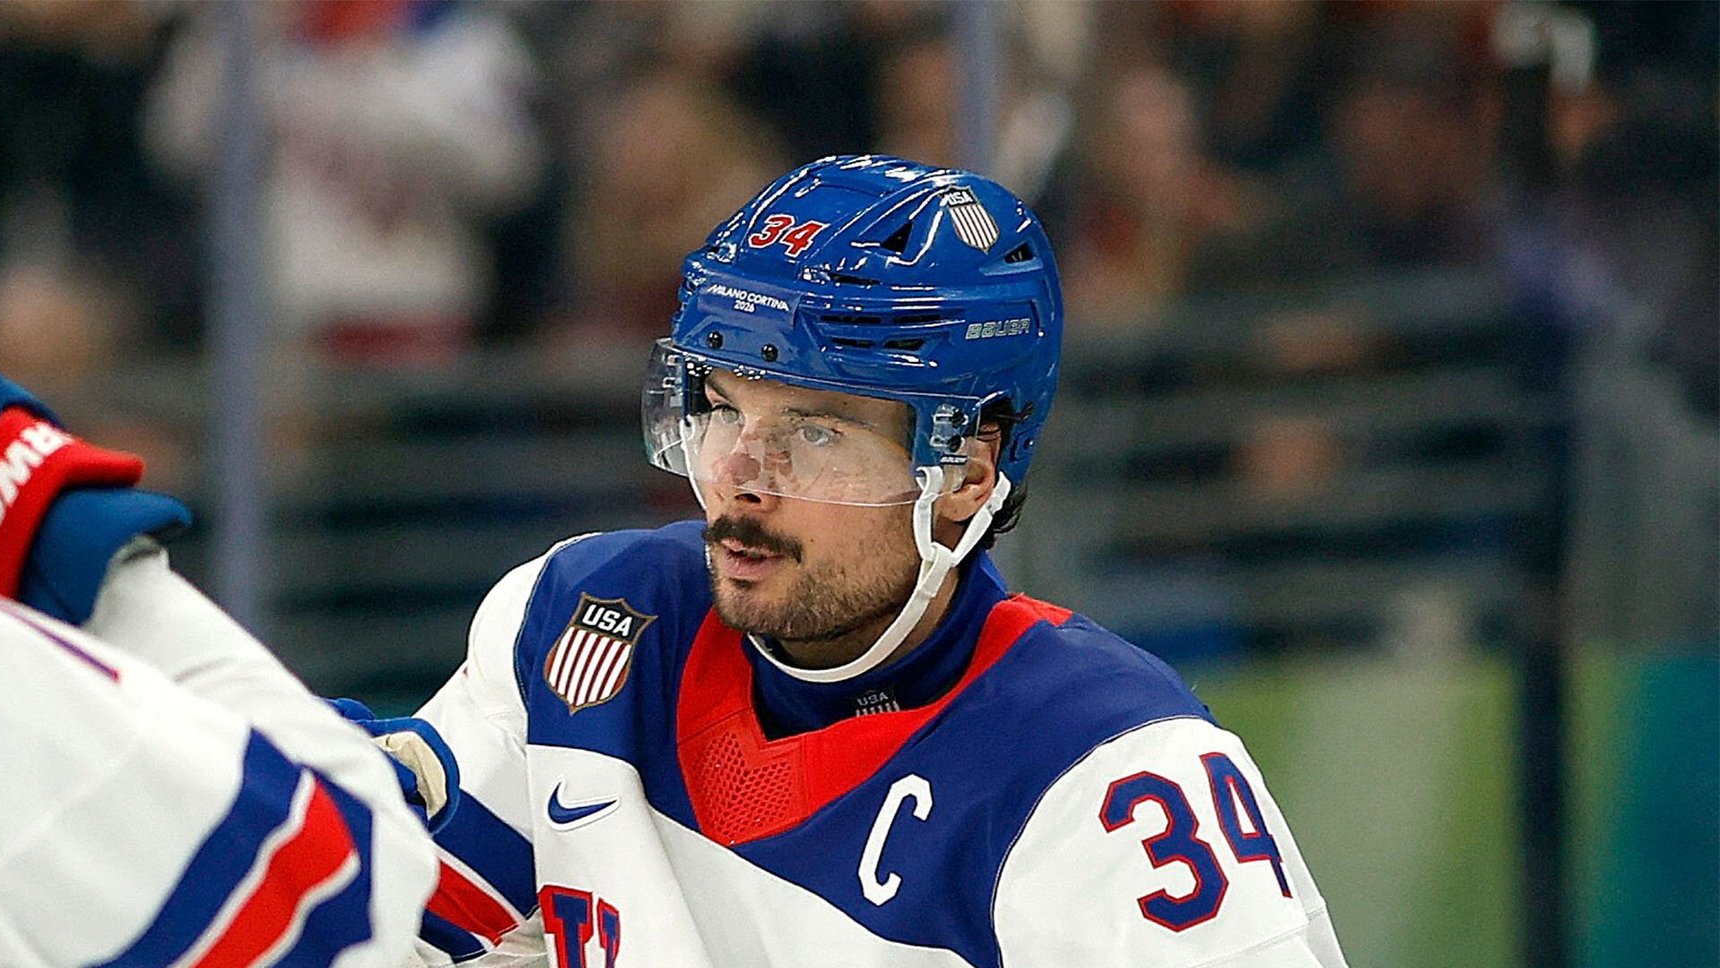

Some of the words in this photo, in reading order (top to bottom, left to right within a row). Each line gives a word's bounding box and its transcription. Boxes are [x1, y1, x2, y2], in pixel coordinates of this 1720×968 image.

[946, 191, 974, 206] USA
[748, 214, 832, 258] 34
[706, 284, 748, 300] MILANO
[747, 292, 790, 312] CORTINA
[723, 299, 756, 313] 2026
[965, 317, 1031, 341] BAUER
[581, 602, 634, 638] USA
[856, 691, 889, 707] USA
[858, 773, 934, 907] C
[1099, 751, 1293, 934] 34
